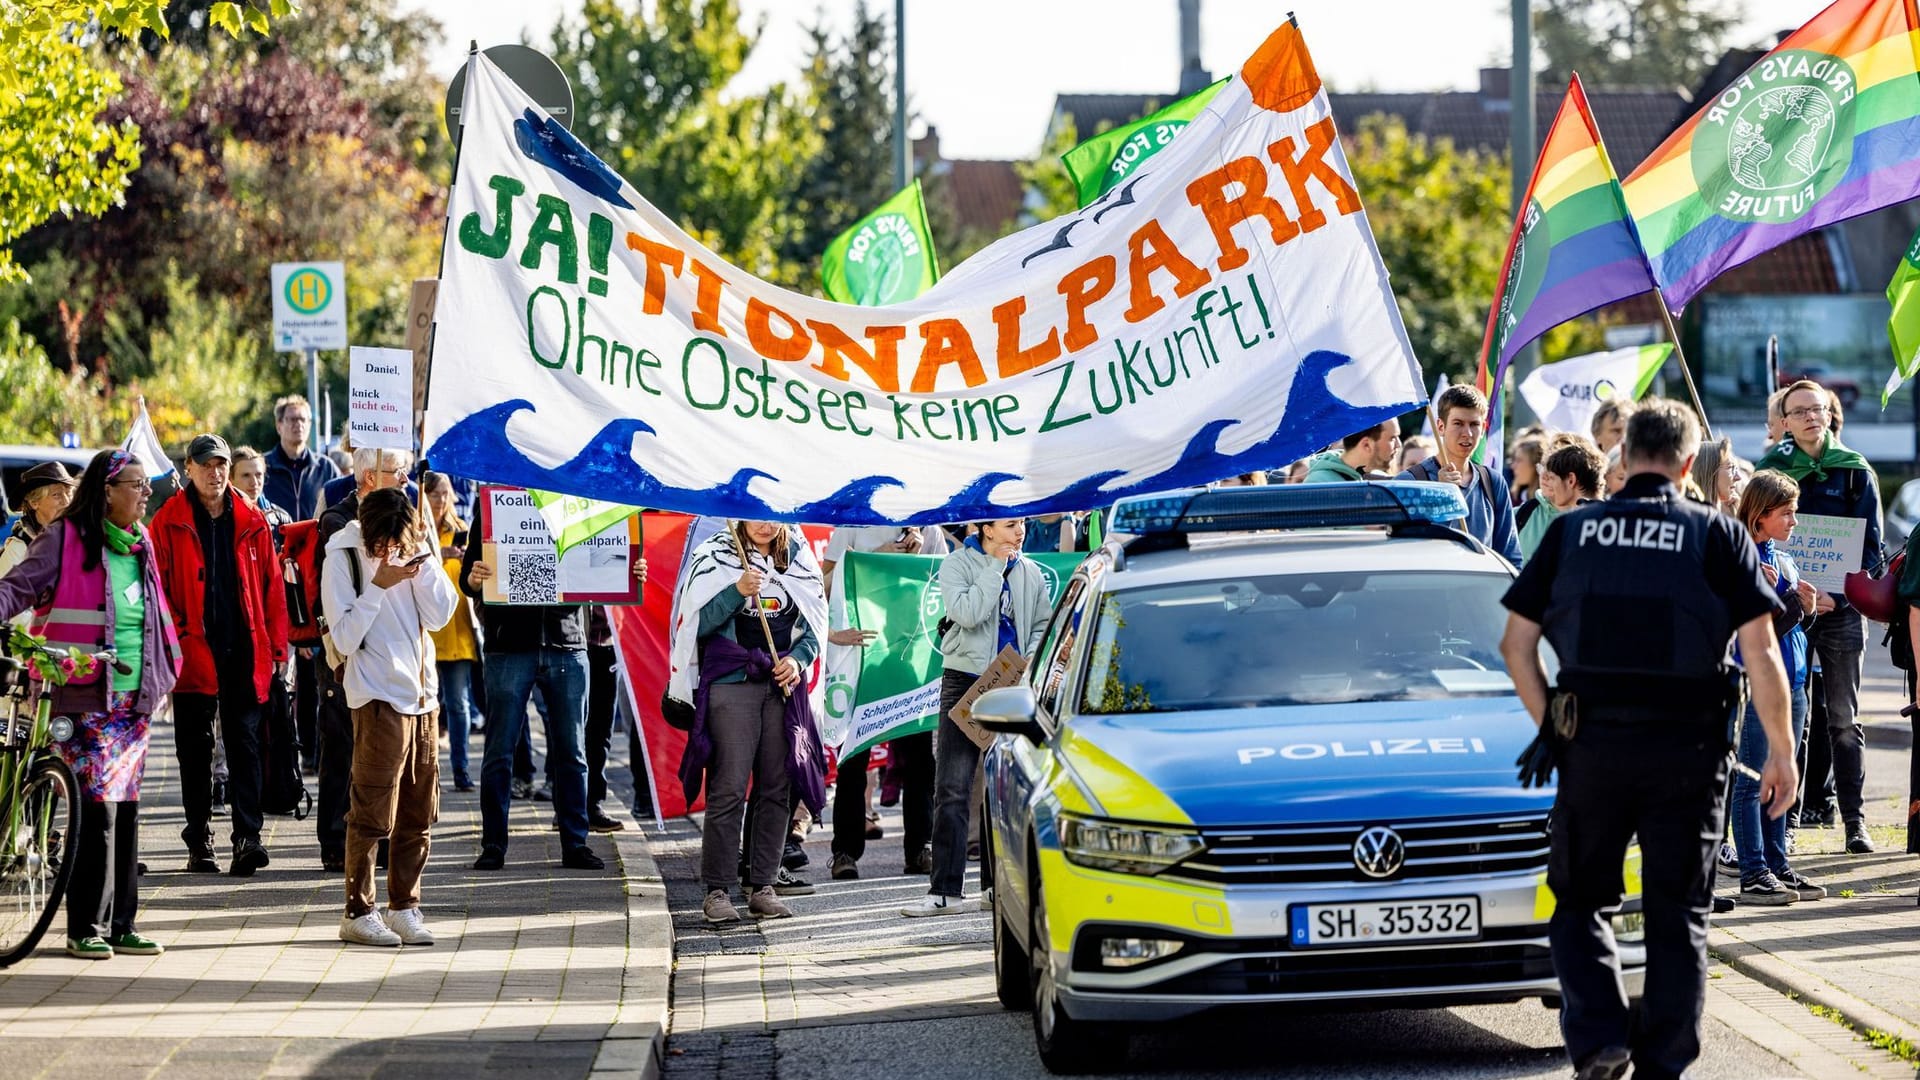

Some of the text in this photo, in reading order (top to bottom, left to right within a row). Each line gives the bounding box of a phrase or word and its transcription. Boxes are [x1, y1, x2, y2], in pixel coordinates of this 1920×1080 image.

[458, 174, 613, 298] JA!
[626, 116, 1363, 394] TIONALPARK
[526, 284, 662, 396] Ohne
[681, 336, 874, 438] Ostsee
[892, 393, 1027, 442] keine
[1032, 273, 1276, 434] Zukunft!
[365, 363, 400, 376] Daniel,
[352, 387, 380, 399] knick
[351, 400, 398, 413] nicht ein,
[351, 421, 380, 432] knick
[500, 533, 515, 544] Ja
[518, 536, 544, 544] zum
[1578, 516, 1685, 553] POLIZEI
[1788, 535, 1833, 549] JA ZUM
[861, 696, 914, 721] Schöpfung
[1236, 736, 1487, 765] POLIZEI
[1317, 909, 1357, 939] SH
[1378, 903, 1473, 935] 35332
